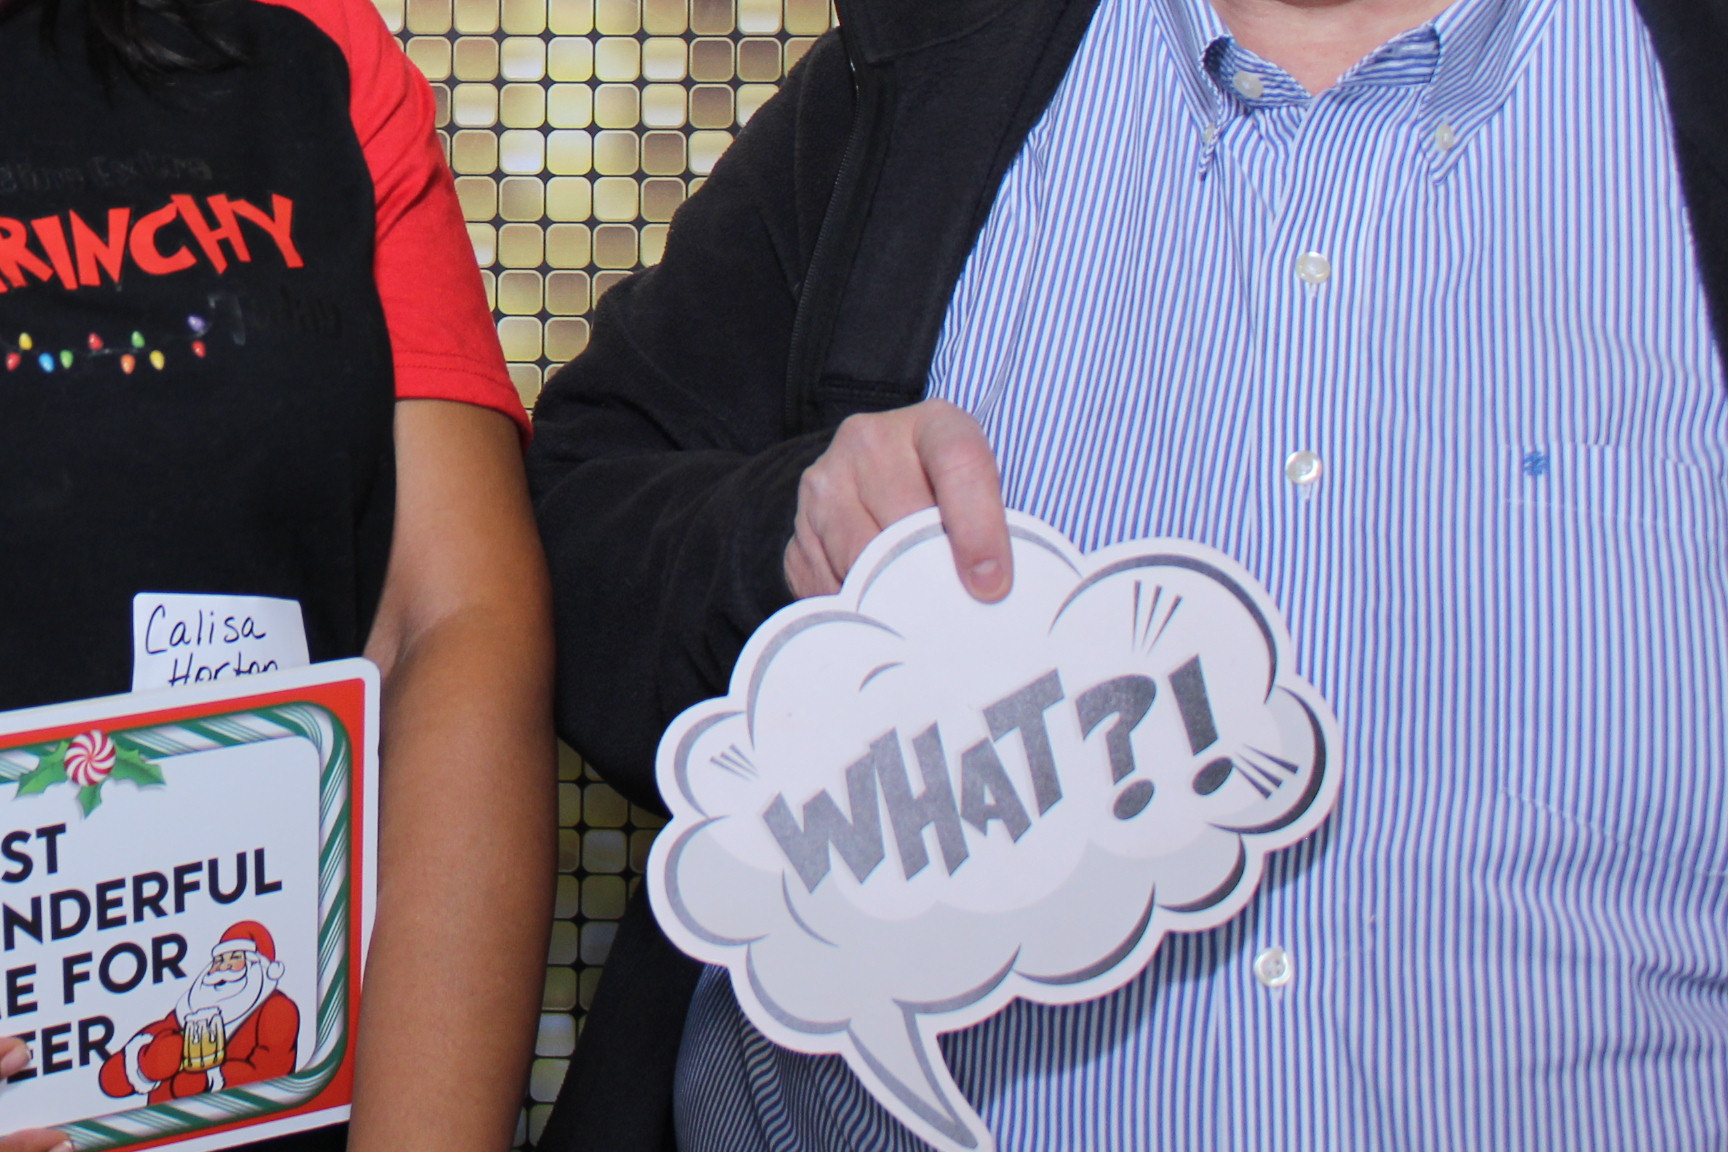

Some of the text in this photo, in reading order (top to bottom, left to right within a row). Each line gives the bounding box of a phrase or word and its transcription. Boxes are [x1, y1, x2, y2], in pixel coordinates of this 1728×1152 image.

[145, 603, 267, 655] Calisa
[762, 654, 1234, 895] WHAT?!
[62, 932, 189, 1006] FOR
[6, 1015, 117, 1085] EER
